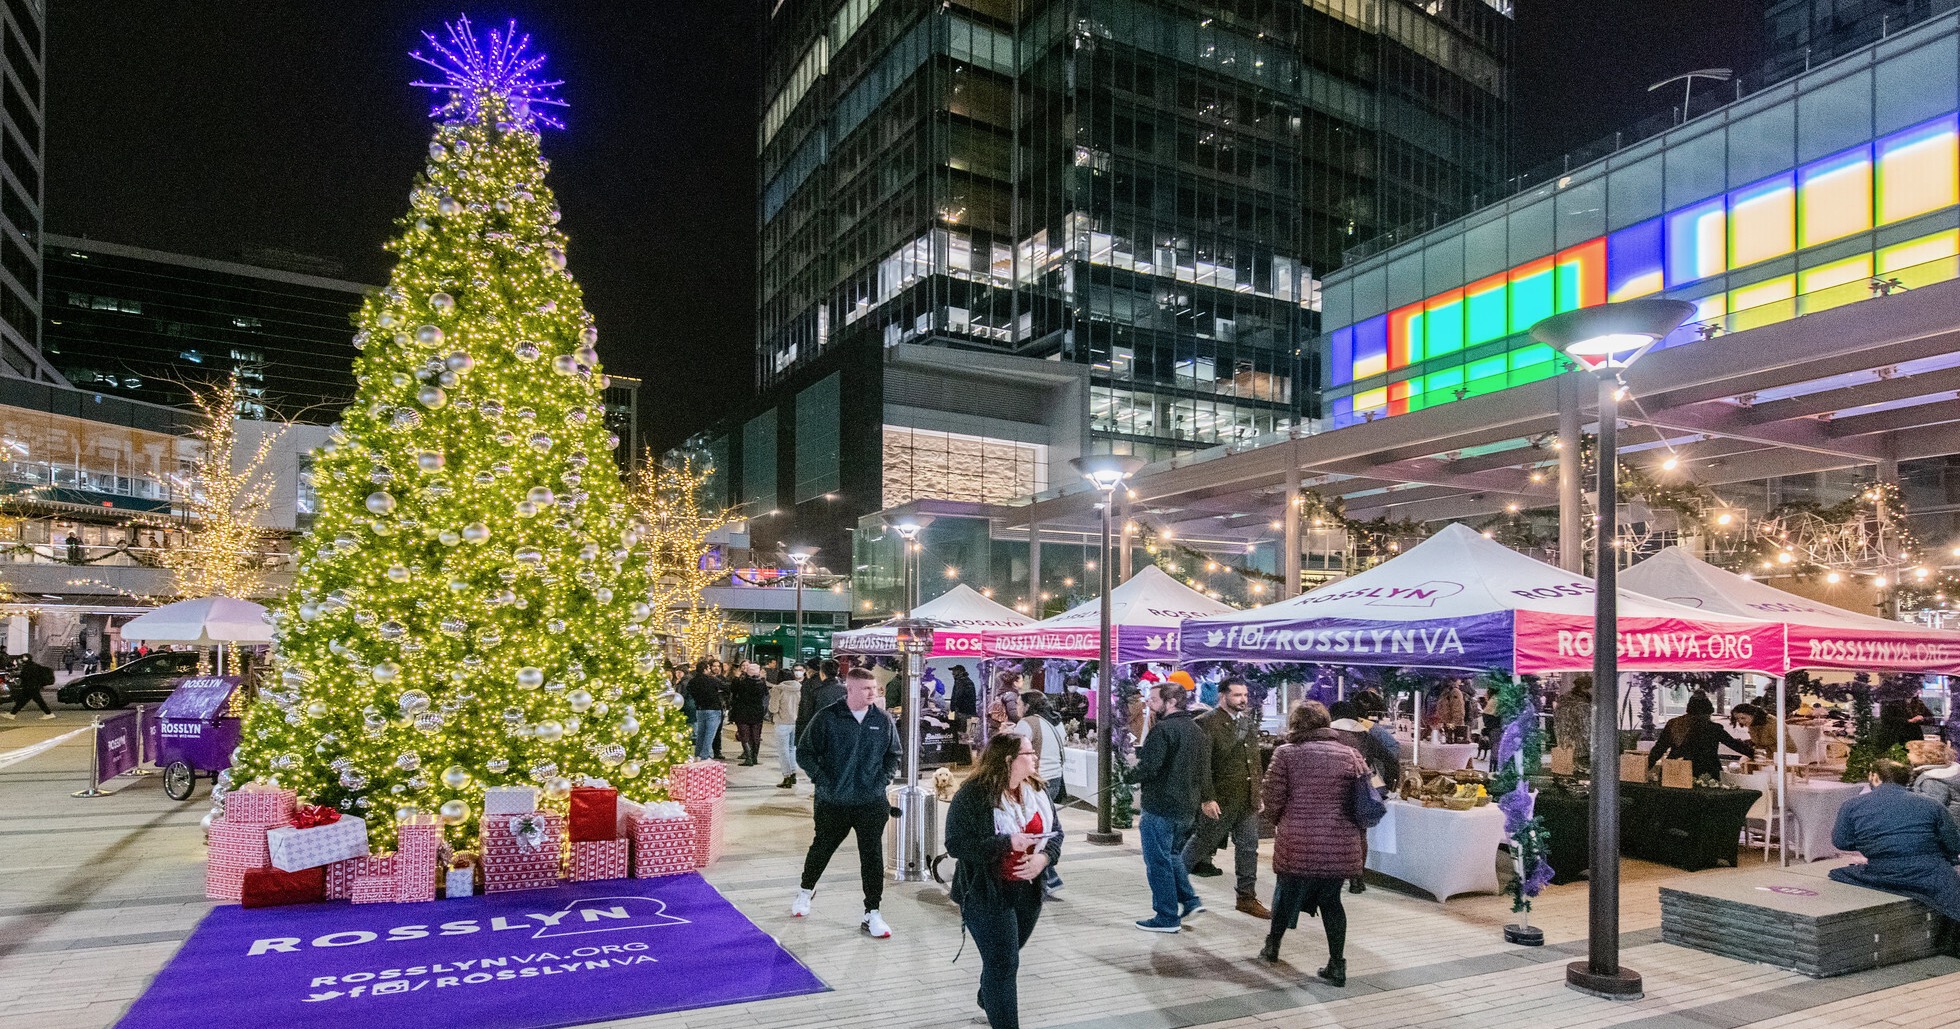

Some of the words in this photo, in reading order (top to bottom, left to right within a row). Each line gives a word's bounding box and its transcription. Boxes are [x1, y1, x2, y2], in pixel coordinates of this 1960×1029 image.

[1294, 586, 1438, 606] ROSSLYN
[1511, 582, 1596, 600] ROSS
[995, 633, 1094, 651] ROSSLYNVA.ORG
[1558, 630, 1753, 659] ROSLYNVA.ORG
[1809, 639, 1951, 662] ROSSLYNVA.ORG
[181, 679, 223, 689] ROSSLYN
[161, 723, 201, 734] ROSSLYN
[247, 906, 631, 957] ROSSLYN
[310, 942, 650, 988] ROSSLYNVA.ORG
